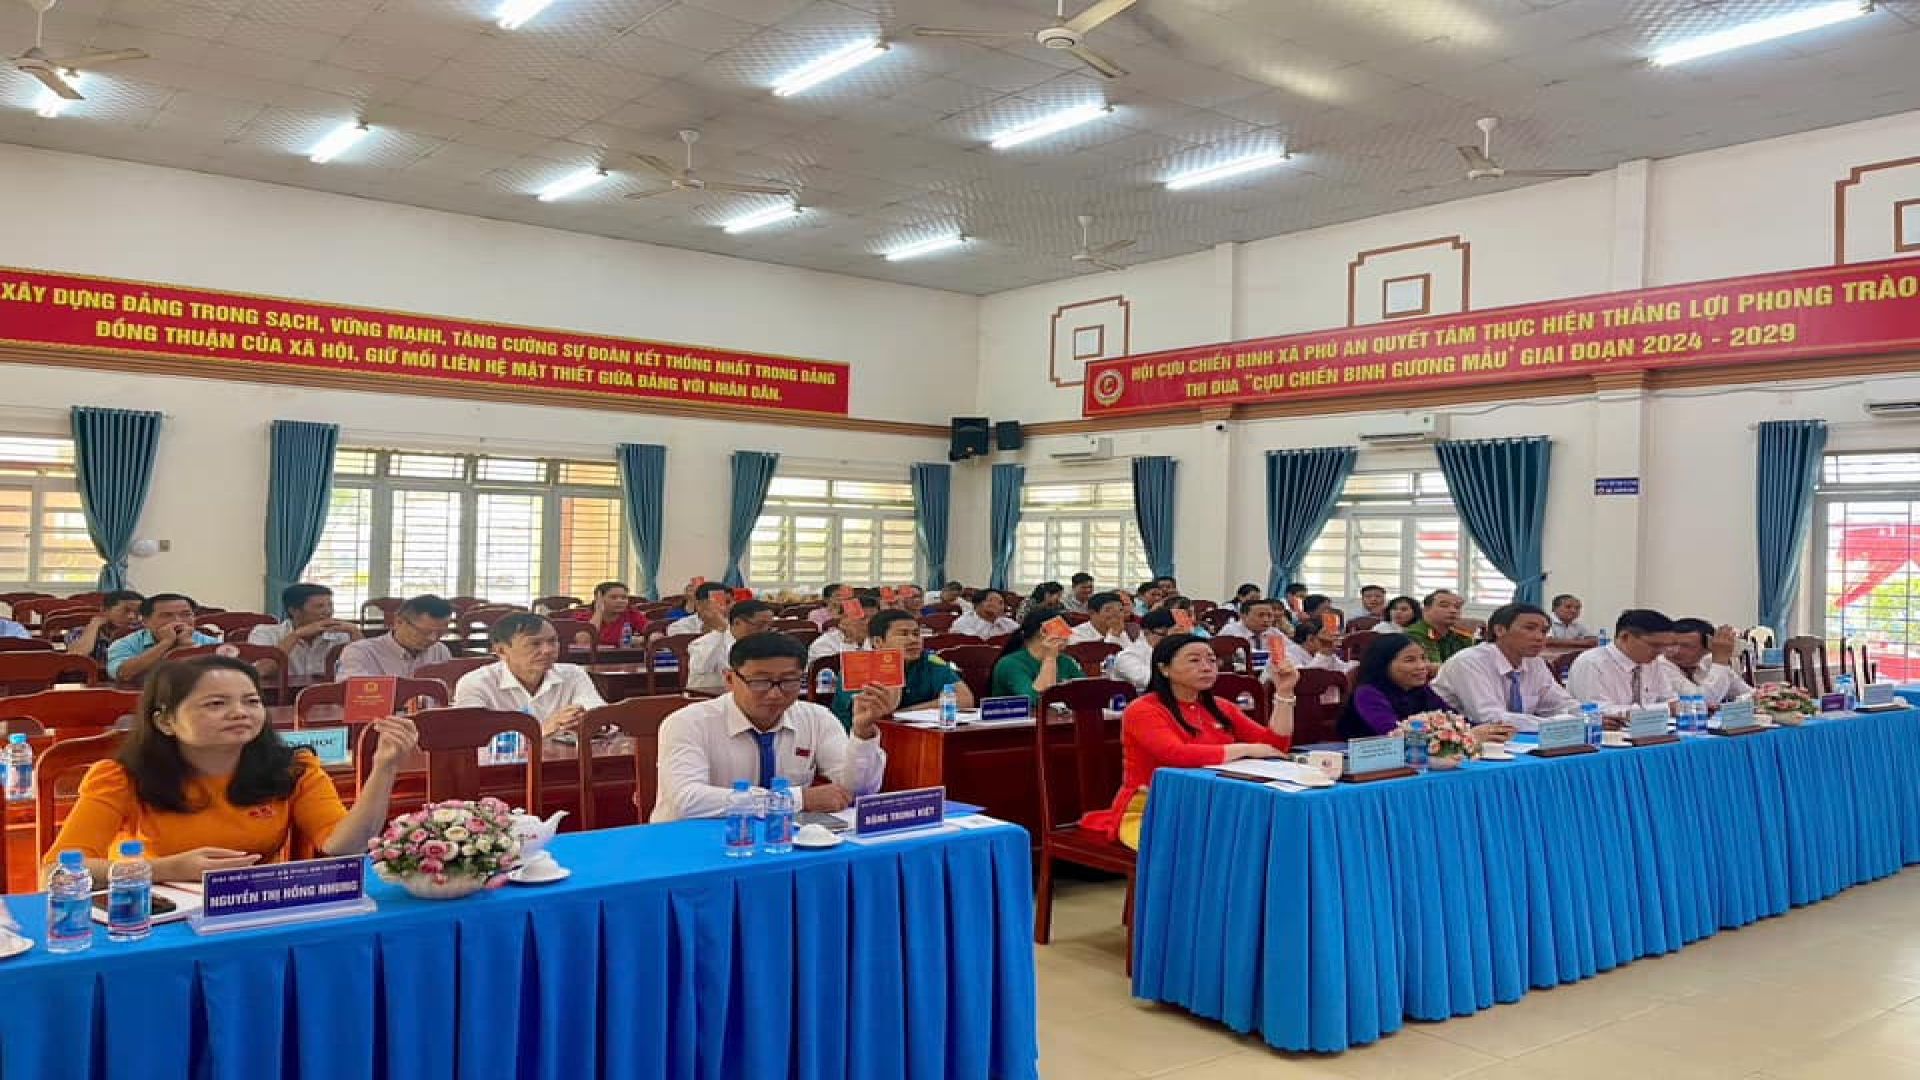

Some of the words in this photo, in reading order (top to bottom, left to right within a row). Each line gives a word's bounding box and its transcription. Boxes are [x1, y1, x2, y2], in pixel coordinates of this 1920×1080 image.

[2, 282, 46, 302] XÂY
[54, 288, 116, 309] DỰNG
[122, 292, 183, 317] ĐẢNG
[190, 302, 259, 325] TRONG
[266, 311, 325, 333] SẠCH,
[330, 316, 382, 338] VỮNG
[388, 322, 447, 346] MẠNH,
[452, 330, 497, 350] TĂNG
[502, 335, 558, 357] CƯỜNG
[588, 345, 630, 363] ĐOÀN
[634, 349, 661, 367] KẾT
[666, 354, 712, 373] THỐNG
[716, 360, 753, 376] NHẤT
[756, 364, 799, 382] TRONG
[96, 319, 158, 342] ĐỒNG
[165, 327, 235, 351] THUẬN
[242, 332, 282, 354] CỦA
[290, 339, 315, 357] XÃ
[366, 346, 398, 365] GIỮ
[442, 353, 480, 373] LIÊN
[486, 357, 507, 377] HỆ
[512, 360, 546, 381] MẬT
[638, 371, 678, 391] ĐẢNG
[709, 381, 747, 397] NHÂN
[752, 384, 783, 401] DÂN.
[1132, 364, 1154, 383] HỘI
[1158, 361, 1185, 380] CỰU
[1189, 353, 1231, 372] CHIẾN
[1236, 350, 1274, 368] BINH
[1278, 346, 1300, 364] XÃ
[1304, 343, 1338, 361] PHÚ
[1344, 338, 1368, 357] AN
[1373, 328, 1428, 353] QUYẾT
[1435, 322, 1478, 346] TÂM
[1483, 318, 1535, 343] THỰC
[1542, 310, 1596, 336] HIỆN
[1603, 298, 1681, 328] THẮNG
[1689, 295, 1729, 323] LỢI
[1738, 285, 1833, 315] PHONG
[1842, 275, 1918, 303] TRÀO
[1185, 383, 1207, 398] THI
[1212, 379, 1239, 395] ĐUA
[1289, 366, 1338, 387] CHIẾN
[1344, 364, 1386, 383] BINH
[1391, 358, 1456, 378] GƯƠNG
[1520, 345, 1565, 367] GIAI
[1571, 338, 1634, 363] ĐOẠN
[1642, 332, 1703, 355] 2024
[1729, 322, 1797, 347] 2029
